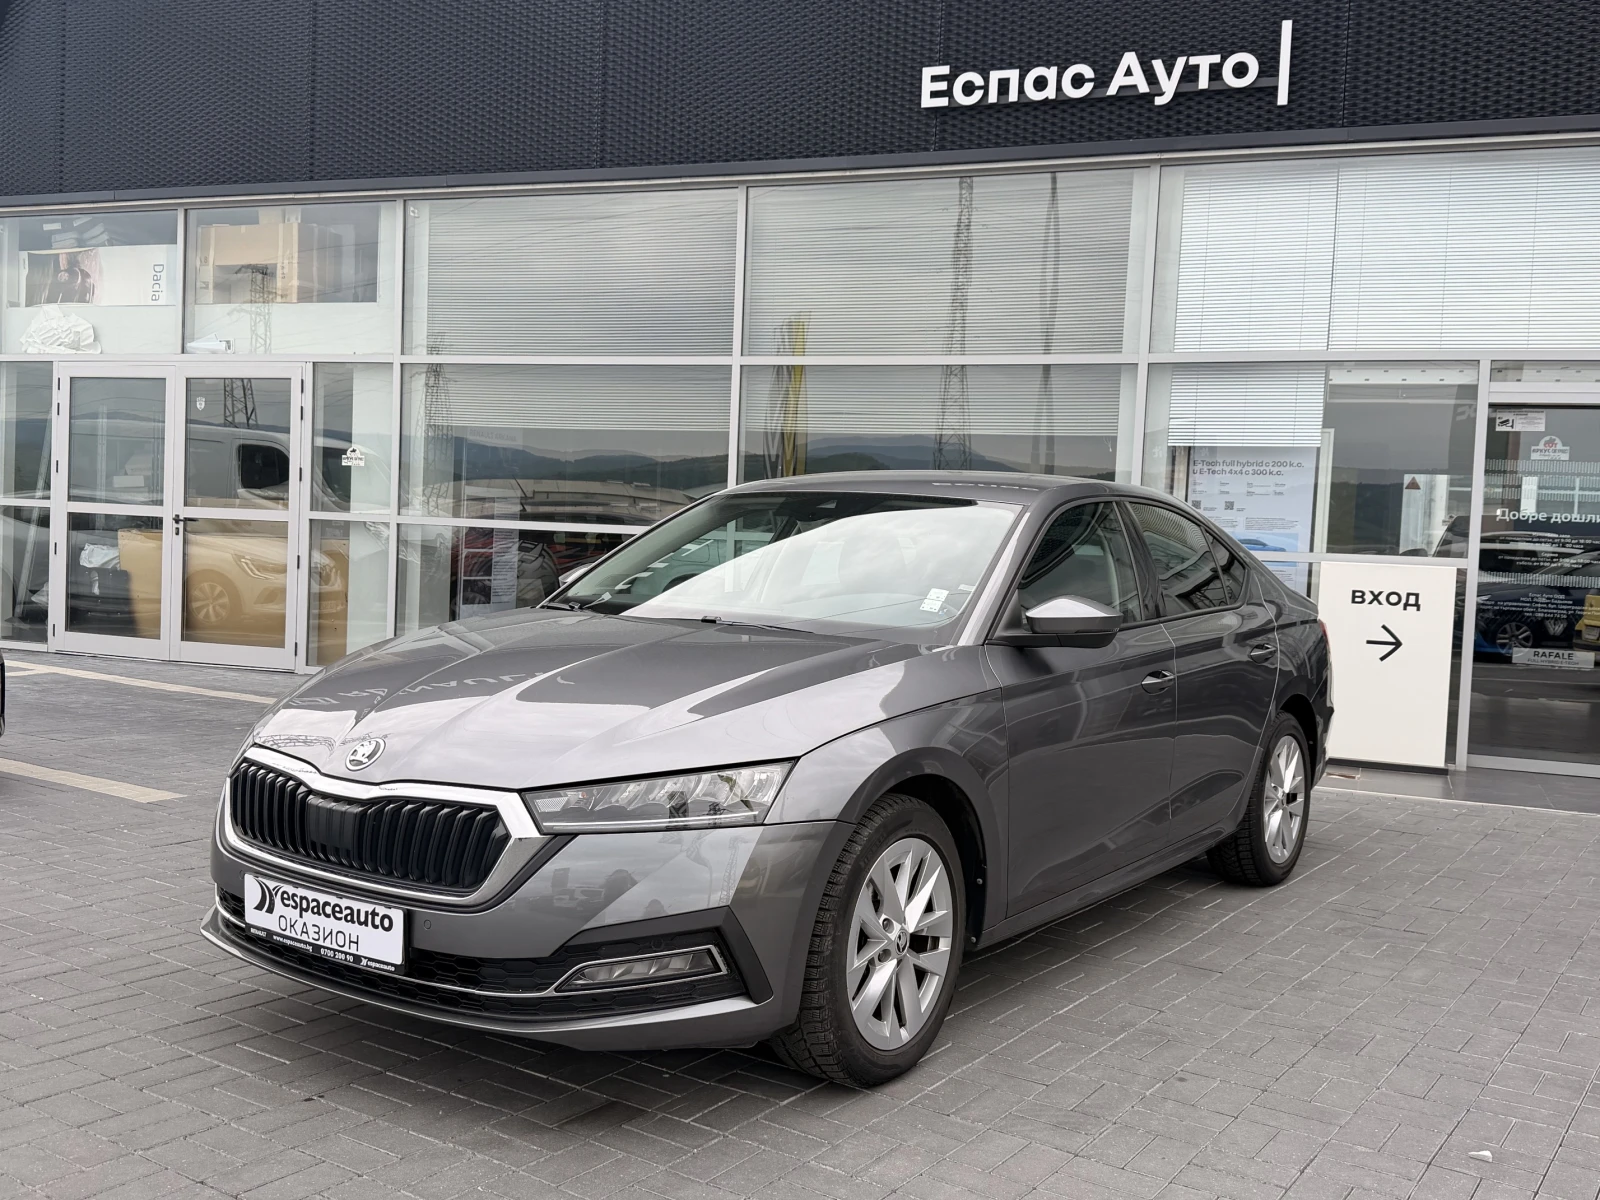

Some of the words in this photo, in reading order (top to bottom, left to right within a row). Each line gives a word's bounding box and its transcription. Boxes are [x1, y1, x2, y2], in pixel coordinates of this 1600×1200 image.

[921, 64, 1095, 108] Еспас
[1106, 51, 1259, 106] Ауто
[151, 264, 164, 302] Dacia
[1237, 460, 1263, 469] hybrid
[1496, 508, 1547, 524] Добре
[1533, 651, 1574, 660] RAFALE
[280, 890, 393, 932] espaceauto
[278, 915, 360, 952] ОКАЗИОН
[321, 948, 334, 957] 0700
[335, 952, 345, 960] 200
[368, 961, 395, 971] espaceauto
